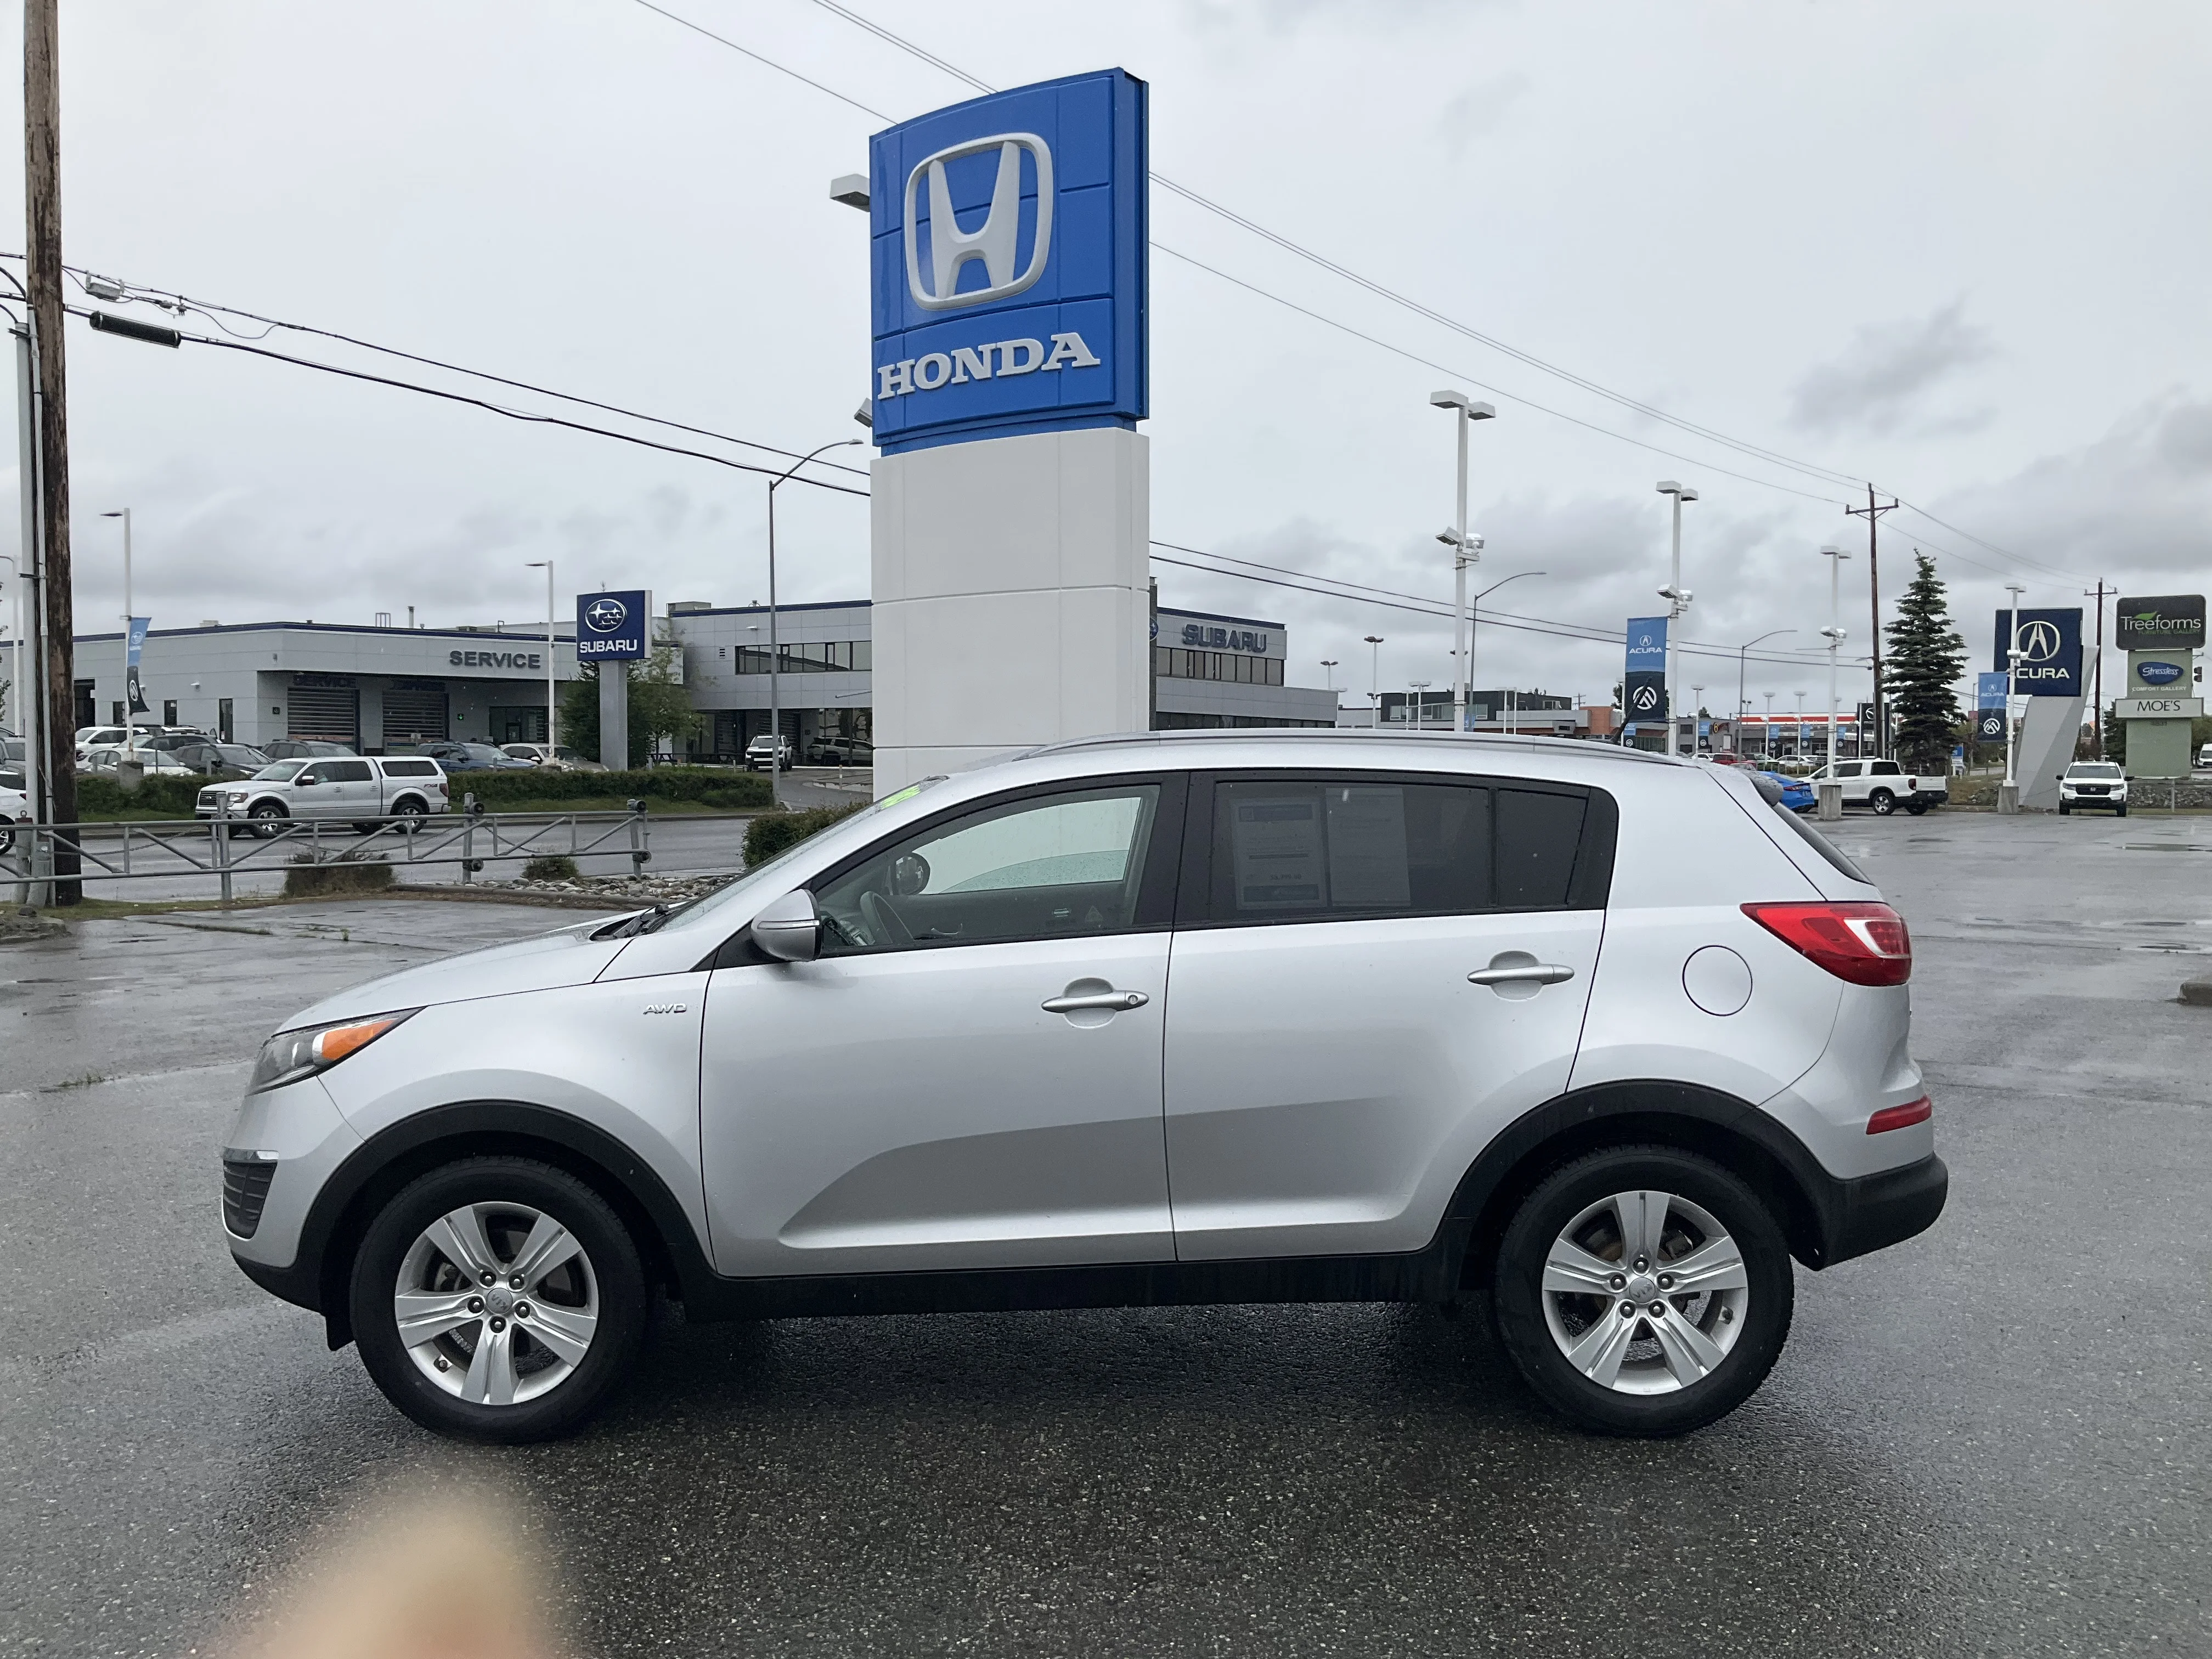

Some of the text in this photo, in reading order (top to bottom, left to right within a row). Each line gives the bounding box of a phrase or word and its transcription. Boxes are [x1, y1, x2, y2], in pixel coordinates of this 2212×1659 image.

[878, 332, 1101, 400] HONDA
[2120, 614, 2202, 630] Treeforms
[579, 639, 637, 653] SUBARU
[1182, 624, 1267, 653] SUBARU
[449, 650, 541, 669] SERVICE
[2142, 667, 2179, 676] Stressless
[2137, 700, 2181, 712] MOE'S
[643, 1003, 687, 1015] AWD
